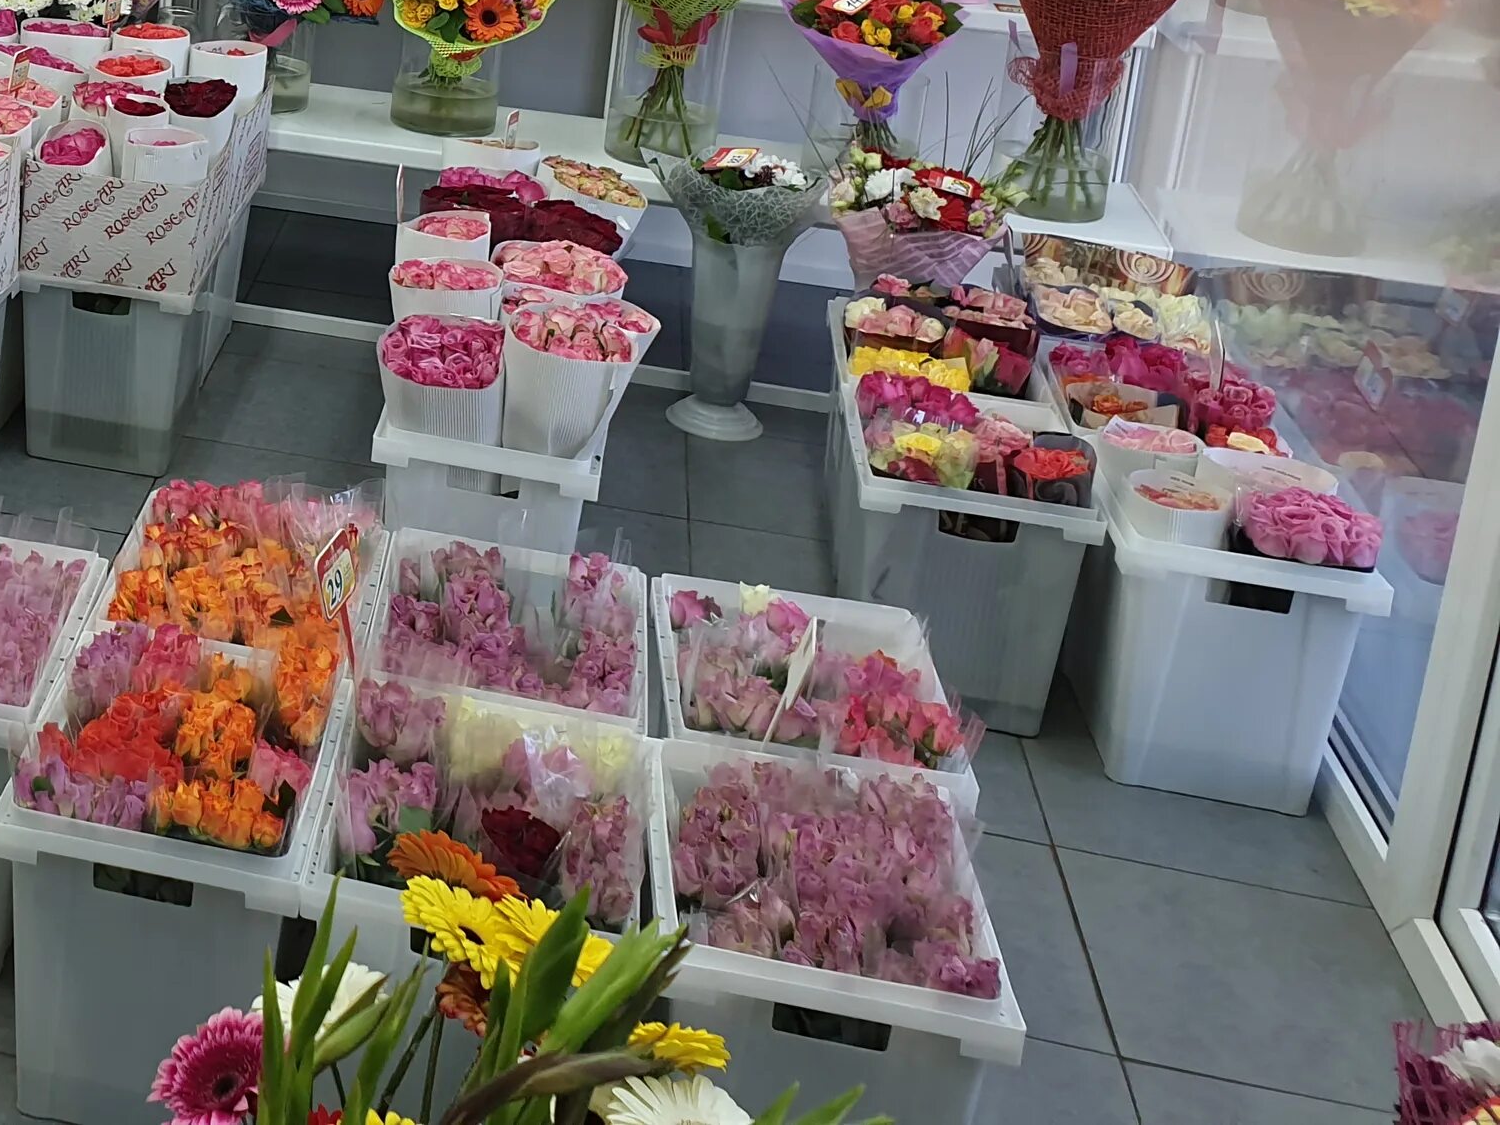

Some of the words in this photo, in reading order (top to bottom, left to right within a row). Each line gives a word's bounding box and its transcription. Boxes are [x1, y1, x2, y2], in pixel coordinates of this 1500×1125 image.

[62, 196, 99, 232] ROSE
[104, 204, 142, 240] ROSE
[145, 209, 182, 246] ROSE
[327, 569, 343, 606] 29
